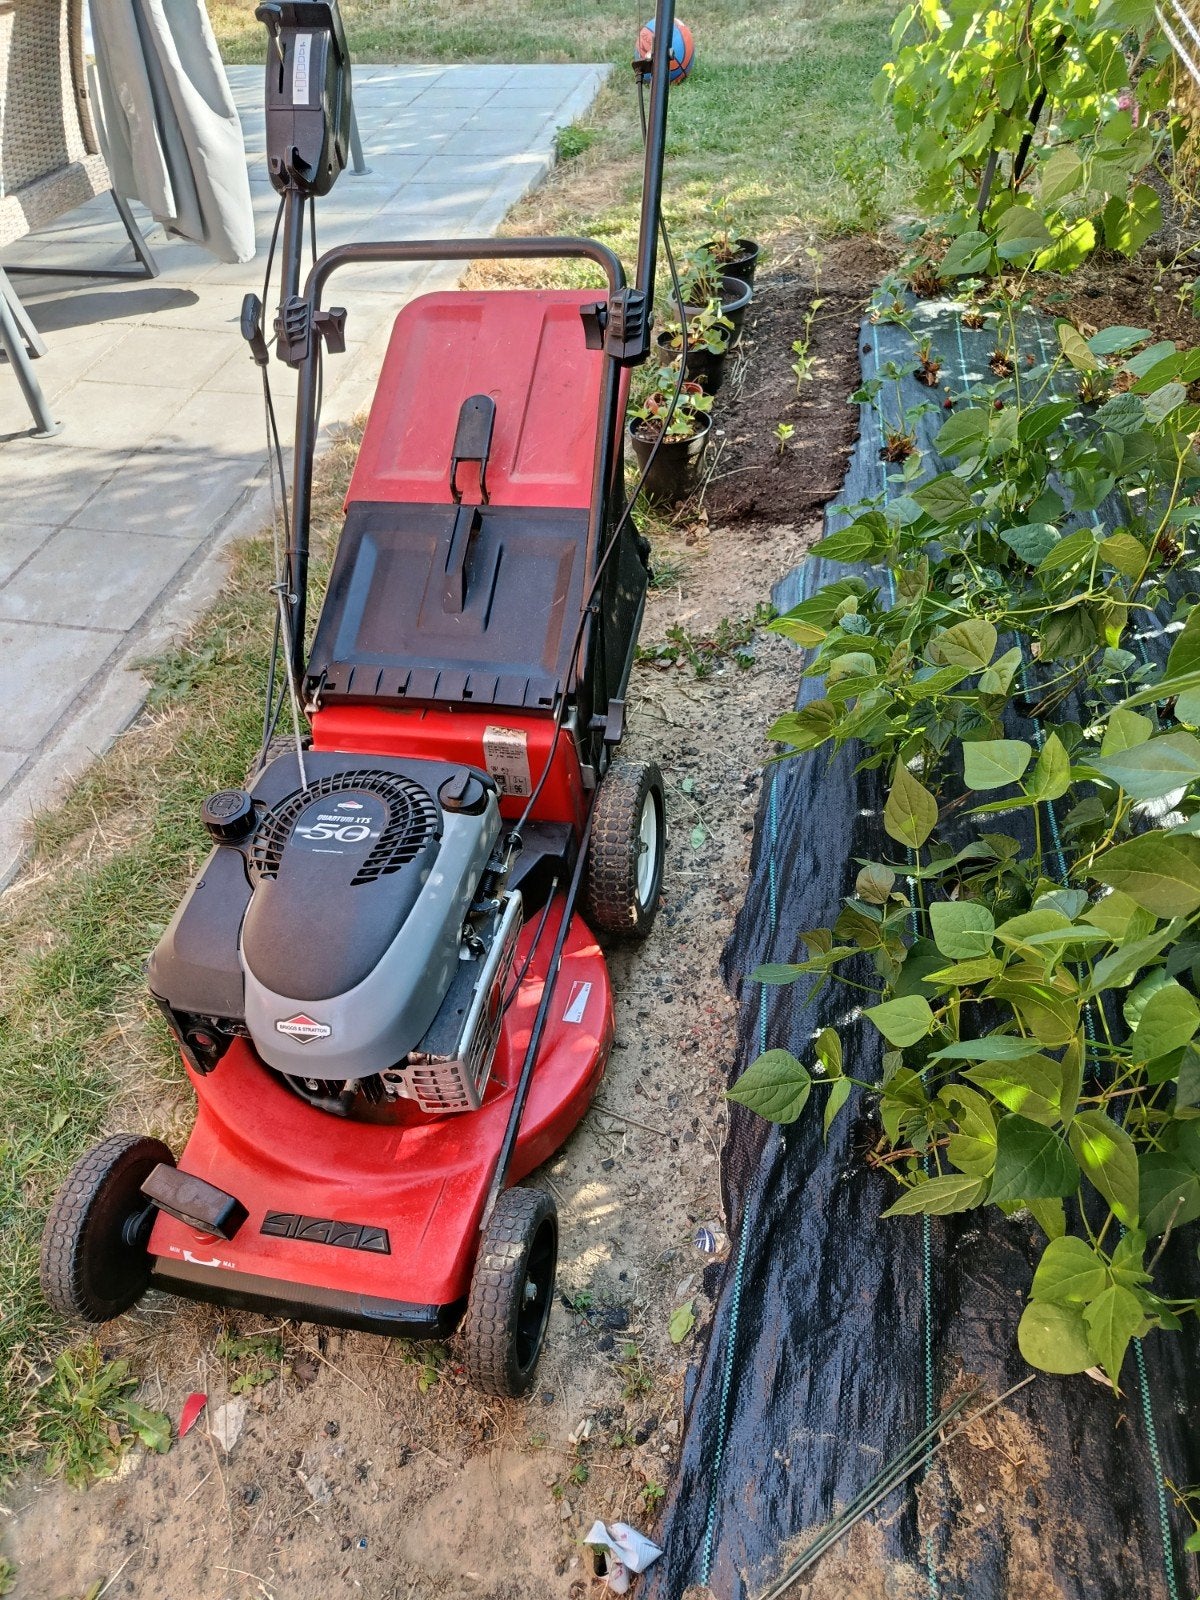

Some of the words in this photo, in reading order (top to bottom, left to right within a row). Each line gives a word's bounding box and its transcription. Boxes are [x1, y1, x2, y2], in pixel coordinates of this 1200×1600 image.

[316, 814, 355, 823] QUANTUM
[301, 822, 371, 843] 50
[279, 1024, 298, 1032] BRIGGS
[302, 1026, 328, 1034] STRATTON
[260, 1210, 391, 1255] SIGMA
[169, 1245, 181, 1254] MIN
[222, 1260, 236, 1269] MAX
